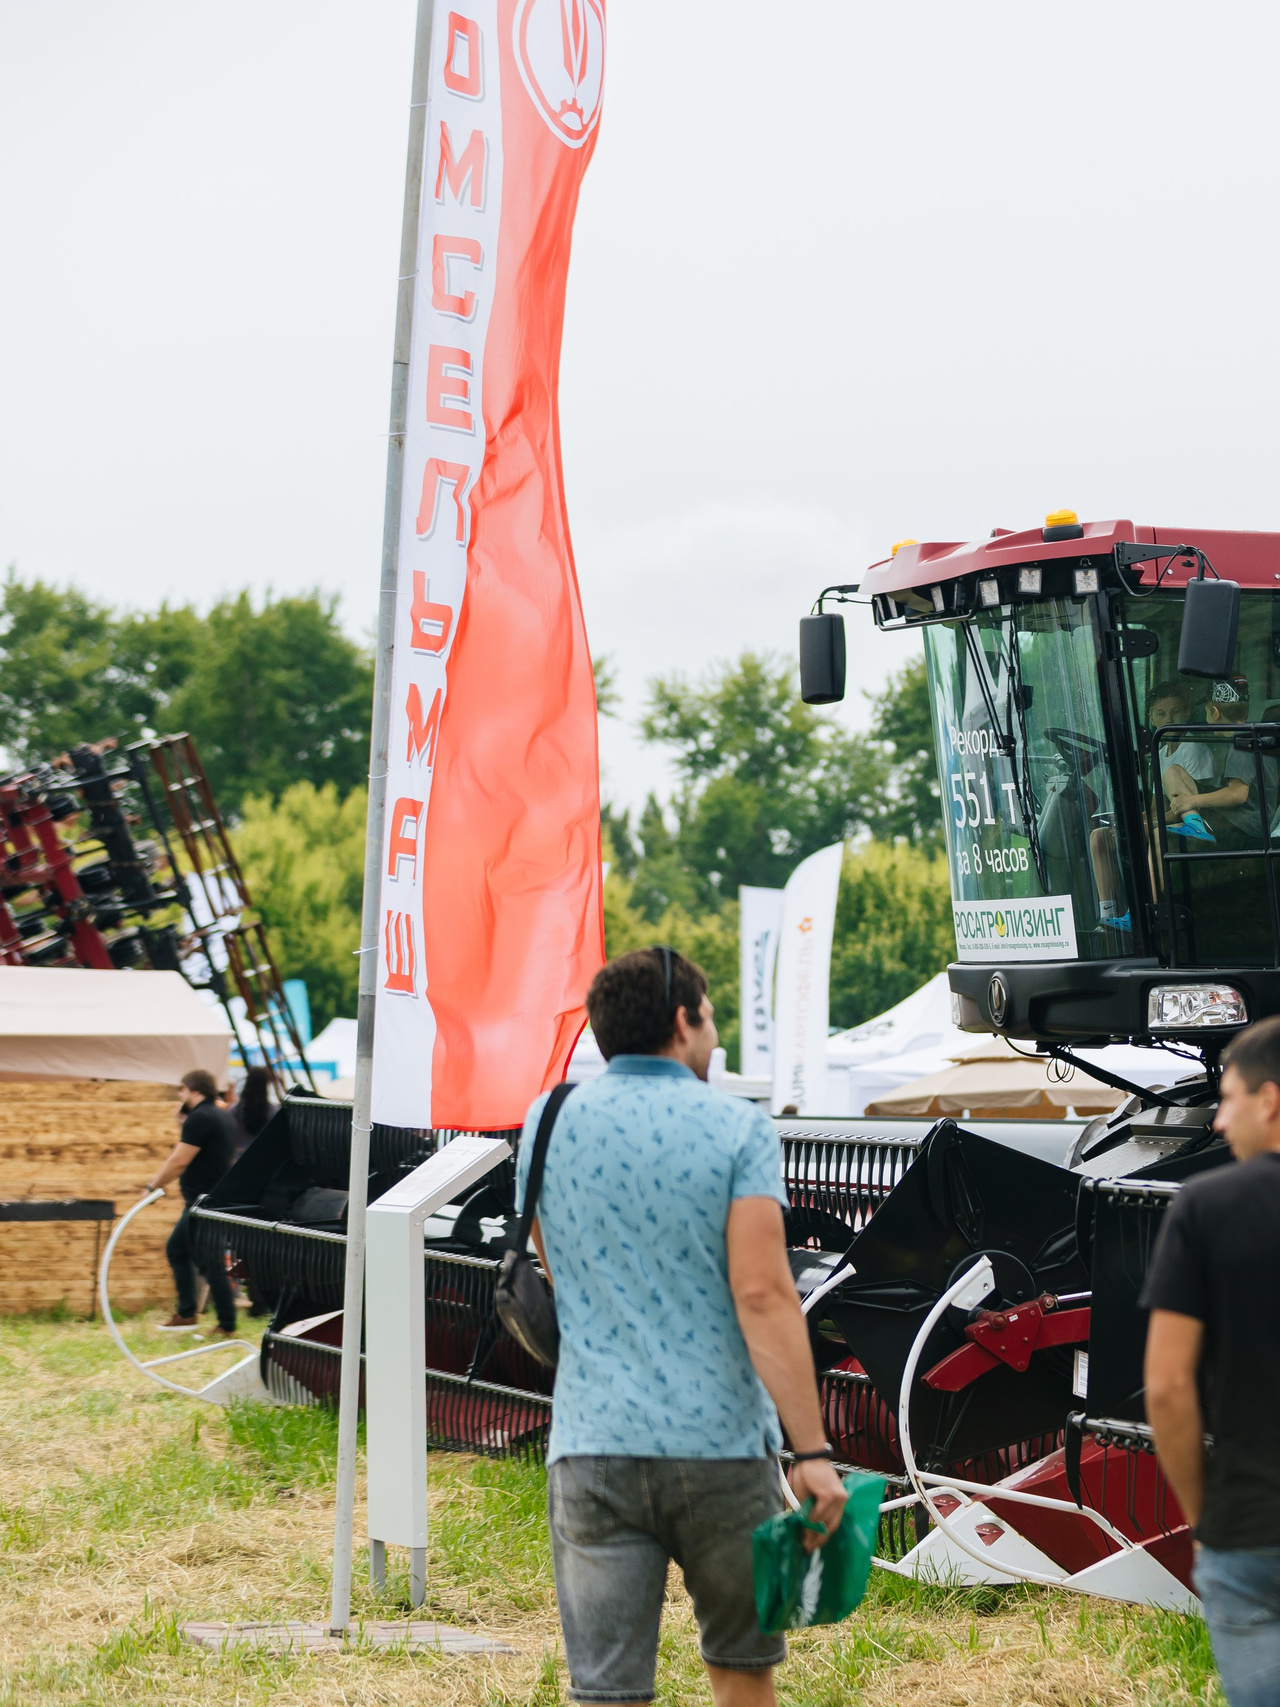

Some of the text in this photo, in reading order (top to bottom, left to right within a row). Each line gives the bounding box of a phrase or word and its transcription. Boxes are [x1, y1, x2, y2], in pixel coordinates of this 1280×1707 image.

[951, 771, 995, 828] 551
[956, 844, 1029, 875] за 8 часов
[955, 907, 1065, 938] РОСАГРОЛИЗИНГ
